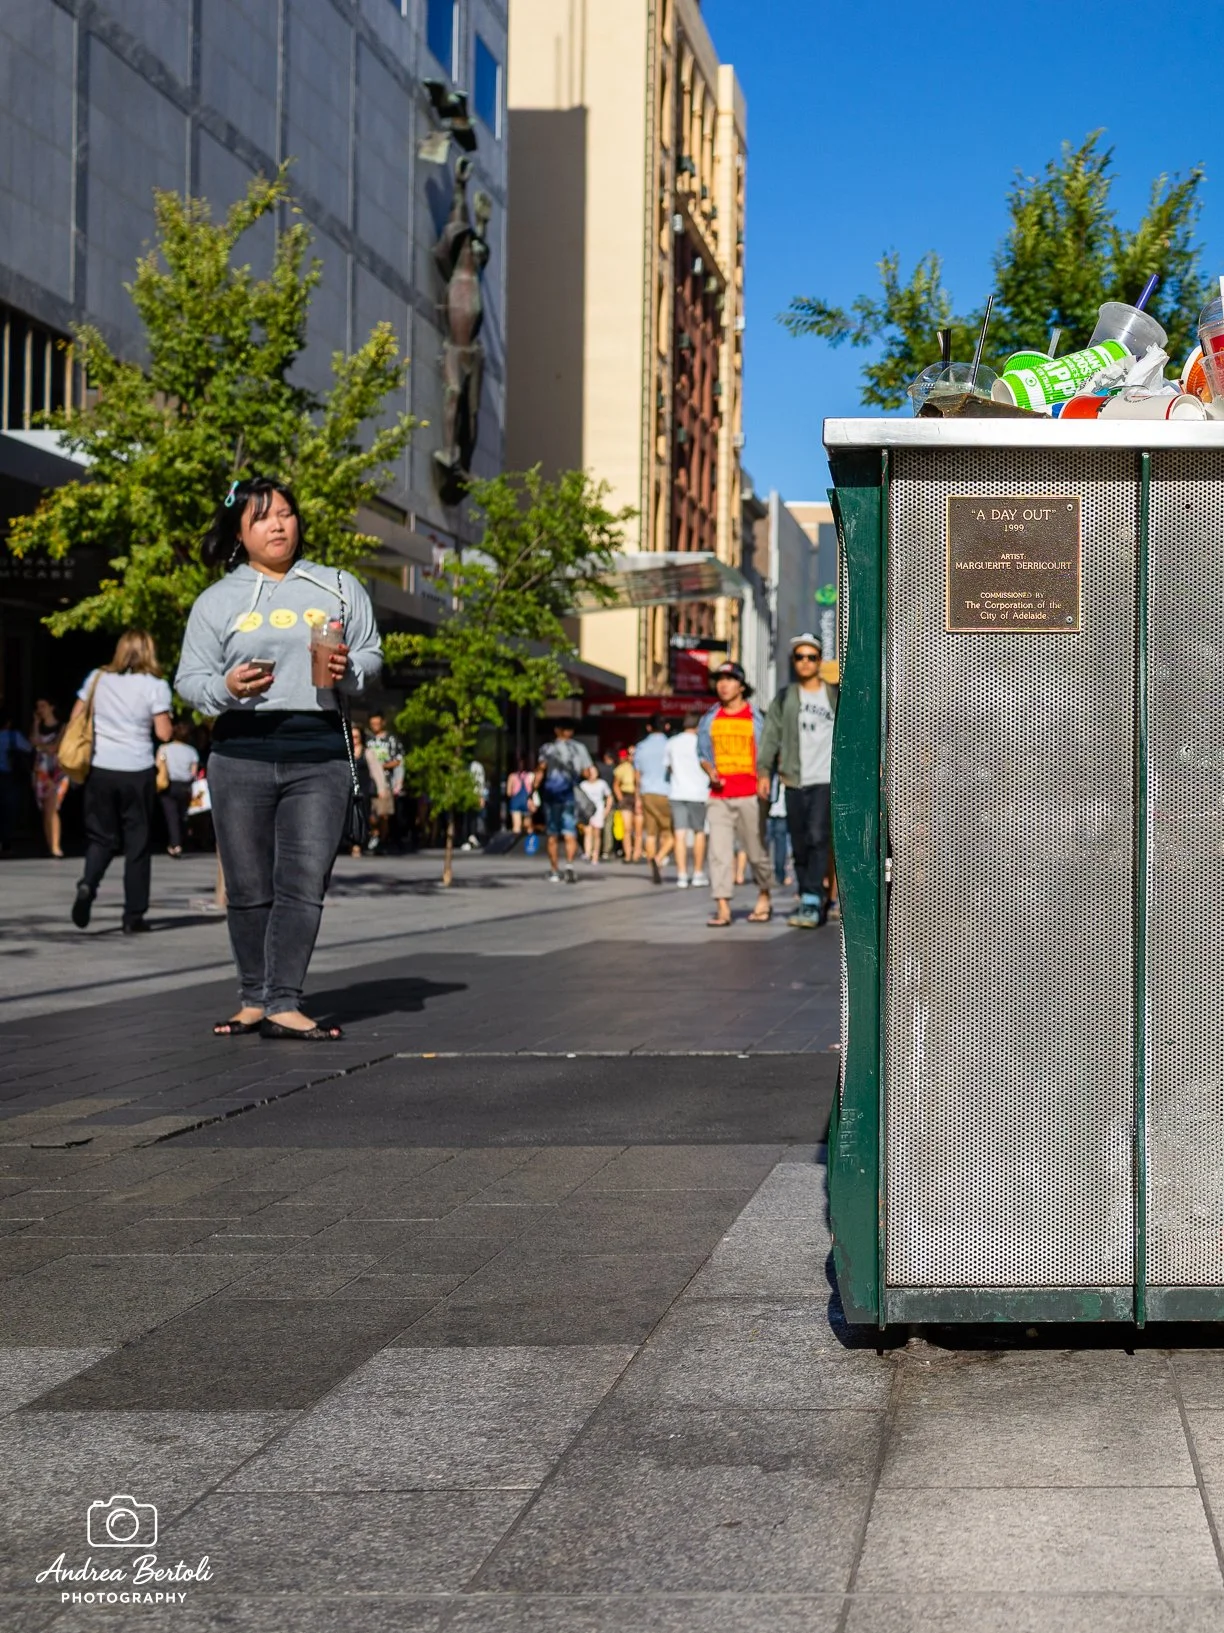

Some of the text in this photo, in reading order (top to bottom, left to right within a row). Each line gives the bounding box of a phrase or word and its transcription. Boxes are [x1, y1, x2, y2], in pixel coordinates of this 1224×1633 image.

[991, 509, 1018, 521] DAY
[1003, 524, 1025, 532] 1999
[955, 561, 1072, 570] MARGUERITE DERRICOURT
[964, 600, 1062, 610] The Corporation of the
[980, 611, 1047, 621] City of Adelaide
